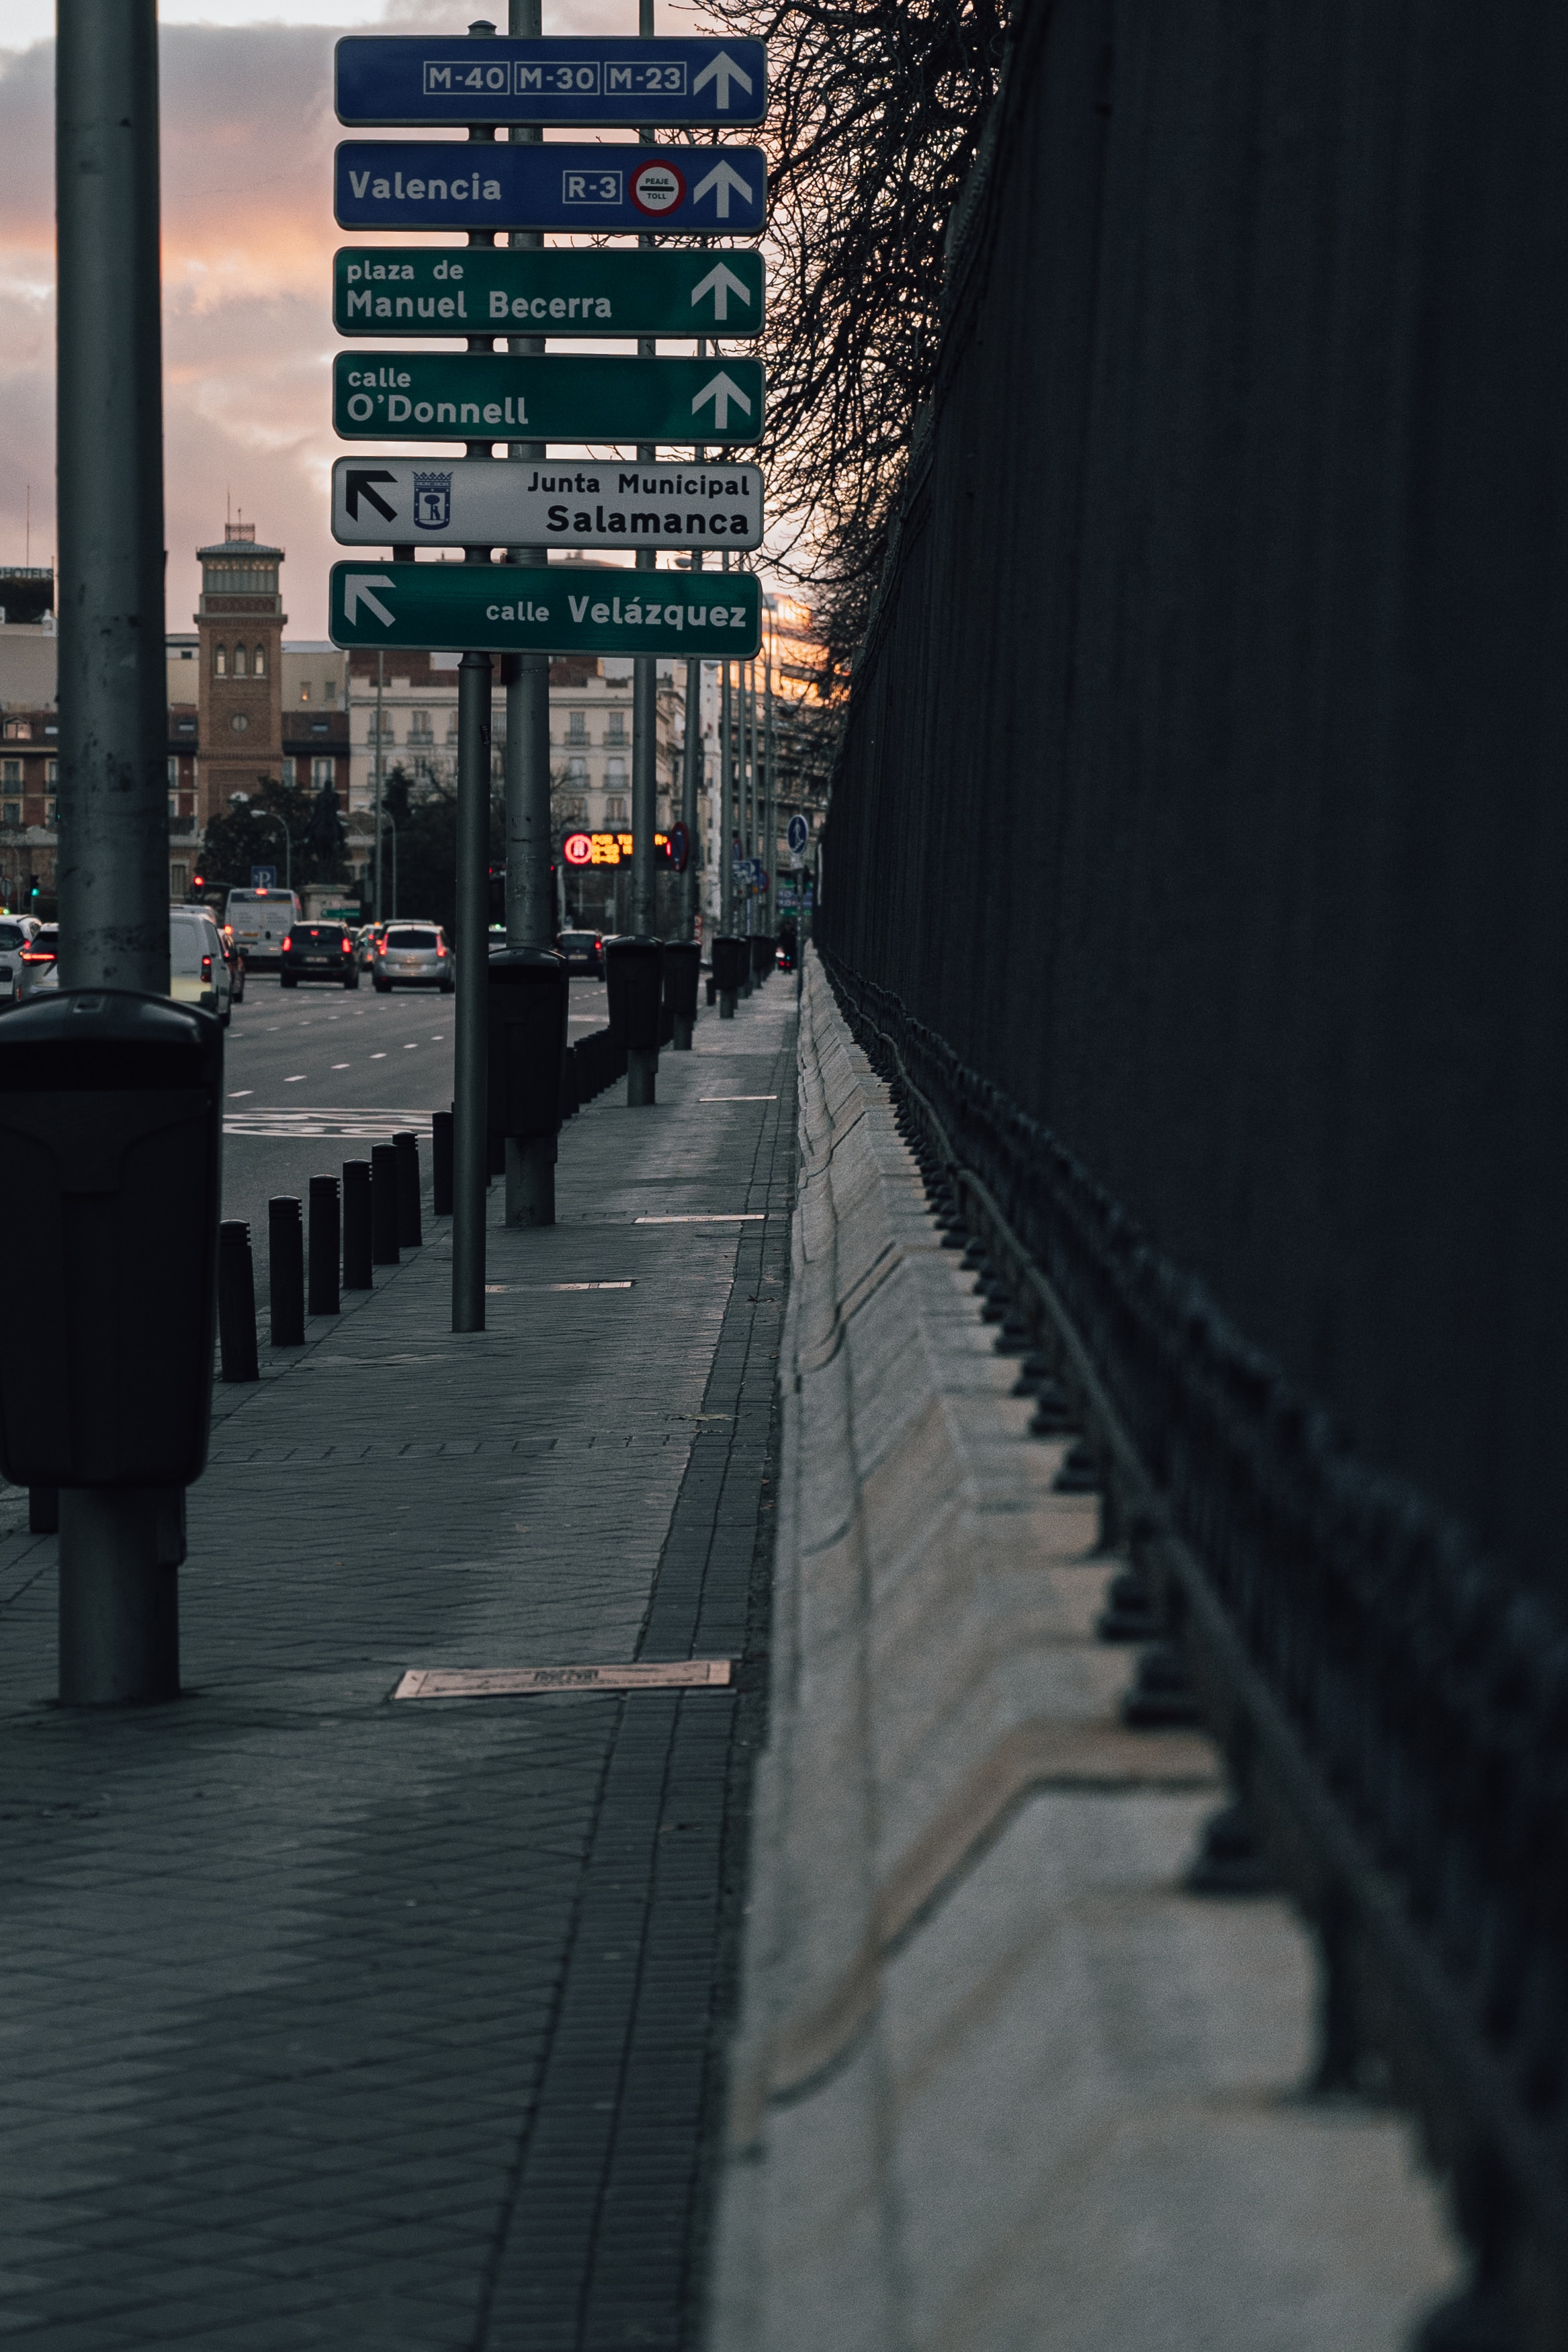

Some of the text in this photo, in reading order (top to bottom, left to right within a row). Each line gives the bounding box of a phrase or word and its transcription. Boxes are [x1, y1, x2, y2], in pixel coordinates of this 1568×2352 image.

[429, 67, 681, 89] M-40 M-30 M-23
[349, 171, 502, 200] Valencia
[568, 176, 617, 199] R-3
[347, 259, 464, 284] plaza de
[347, 290, 612, 318] Manuel Becerra
[348, 367, 411, 388] calle
[347, 393, 529, 425] O'Donnell
[527, 472, 750, 499] Junta Municipal
[546, 505, 749, 535] Salamanca
[486, 595, 746, 631] calle Velázquez
